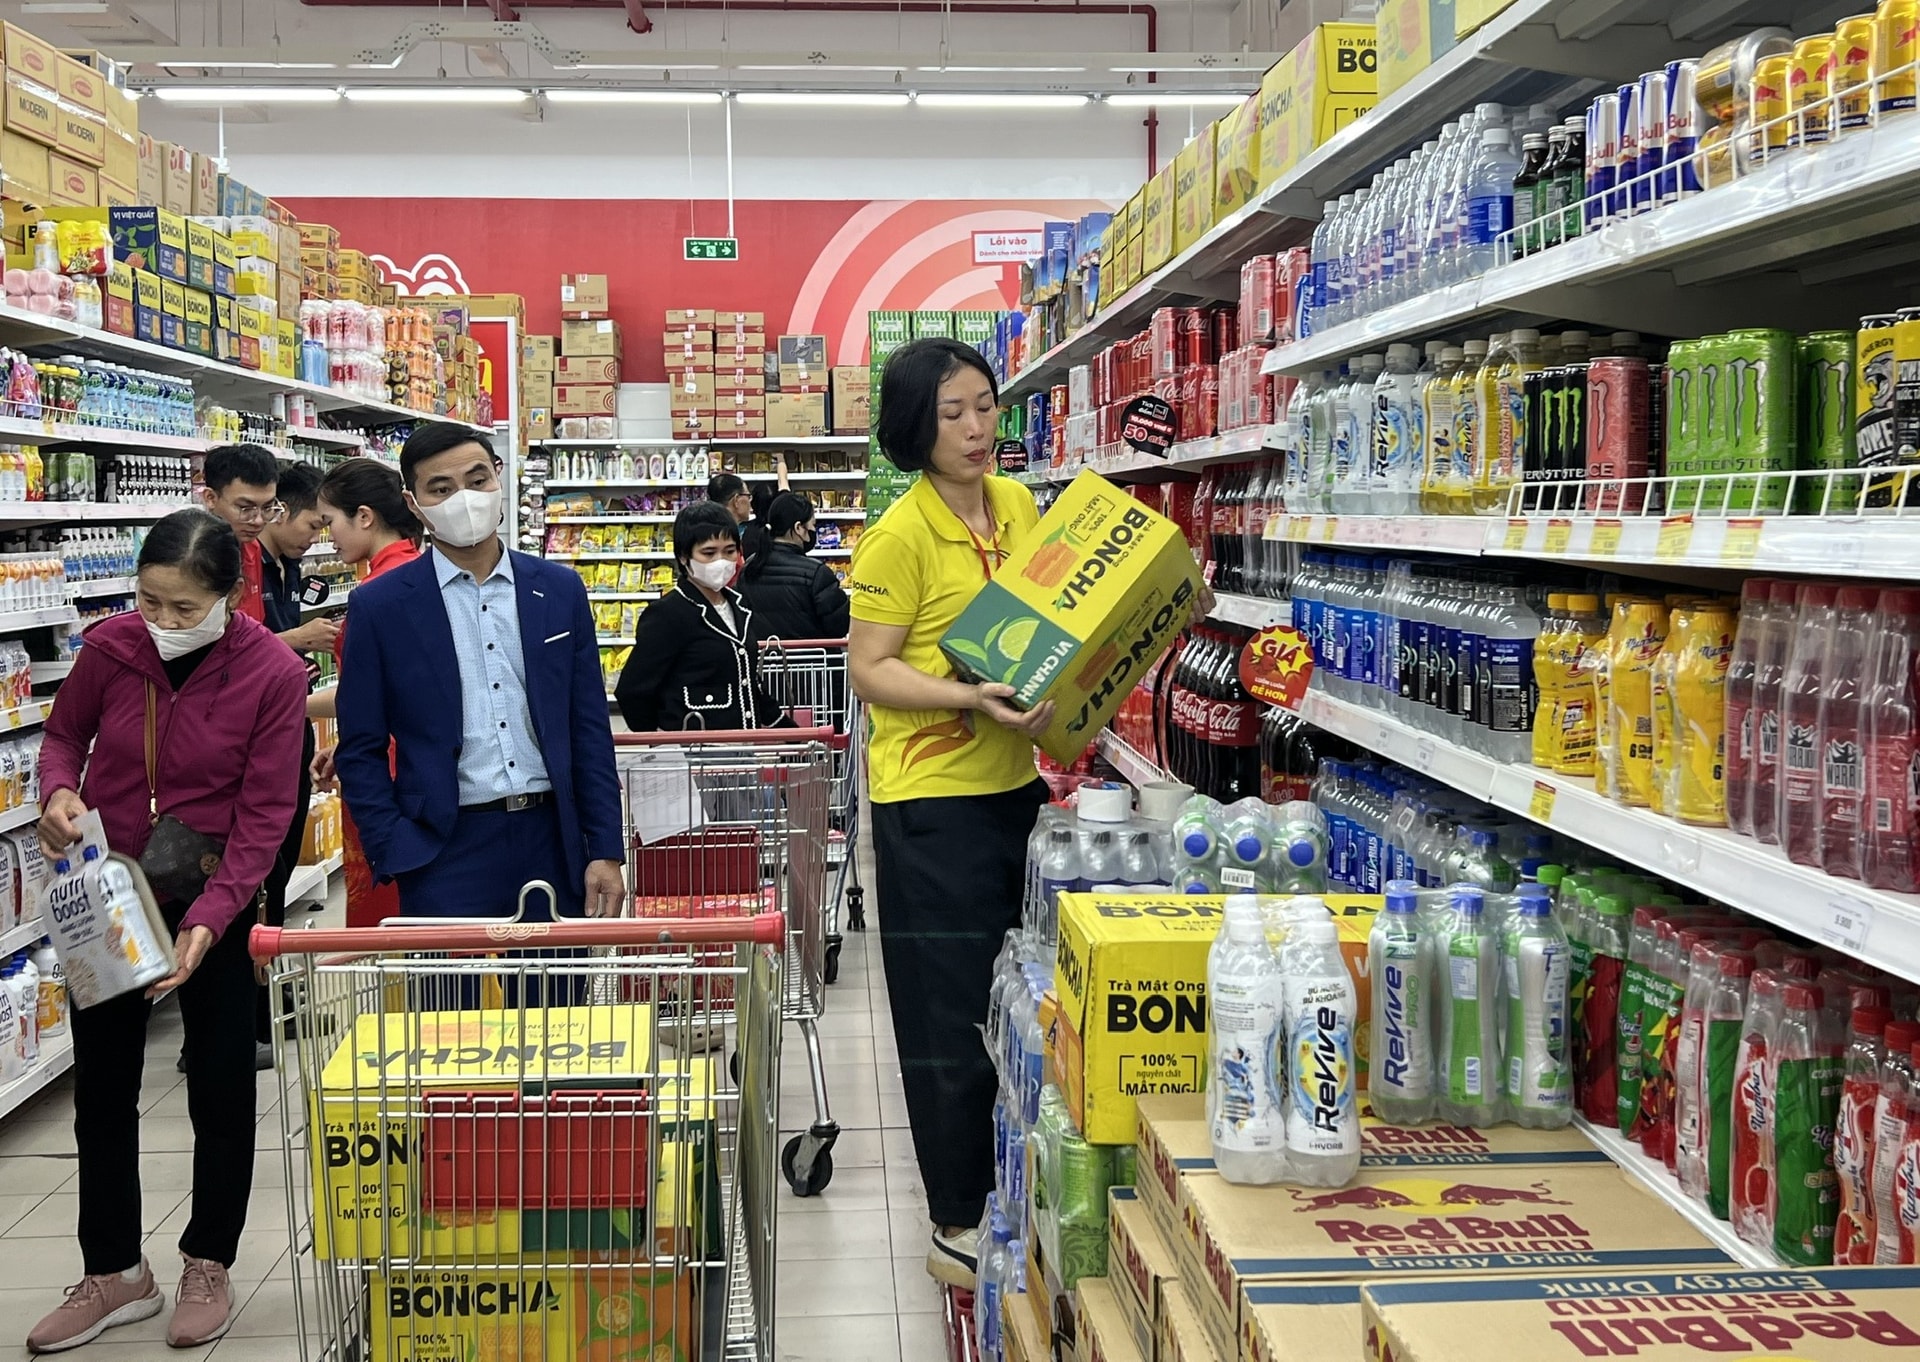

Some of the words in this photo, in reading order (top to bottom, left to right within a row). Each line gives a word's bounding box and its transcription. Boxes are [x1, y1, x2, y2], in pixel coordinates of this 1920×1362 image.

[19, 96, 48, 122] MODERN
[67, 121, 96, 144] MODERN
[1123, 423, 1148, 442] 50
[1069, 512, 1086, 531] ONG
[1089, 513, 1108, 532] 100%
[1051, 506, 1149, 613] BONCHA
[1051, 640, 1074, 657] VỊ
[1065, 577, 1194, 736] BONCHA
[1017, 655, 1060, 702] CHANH
[1266, 688, 1287, 702] HƠN
[1209, 703, 1245, 731] Cola
[1629, 744, 1637, 758] 6
[52, 890, 91, 923] boost
[1058, 931, 1084, 1004] BONCHA
[1108, 980, 1132, 991] Trà
[1138, 980, 1168, 993] Mật
[1174, 980, 1205, 994] Ong
[1107, 994, 1210, 1034] BON
[356, 1041, 627, 1068] BONCHA
[1140, 1054, 1177, 1067] 100%
[1136, 1071, 1164, 1079] nguyên
[1165, 1069, 1181, 1078] chất
[1407, 1153, 1494, 1164] Drink
[374, 1207, 401, 1218] OG
[1369, 1256, 1489, 1270] Energy
[1502, 1252, 1600, 1265] Drink
[388, 1274, 405, 1284] rà
[441, 1272, 469, 1284] Ong
[1674, 1275, 1827, 1291] Energy
[1541, 1279, 1661, 1297] Drink
[385, 1280, 562, 1318] BONCHA
